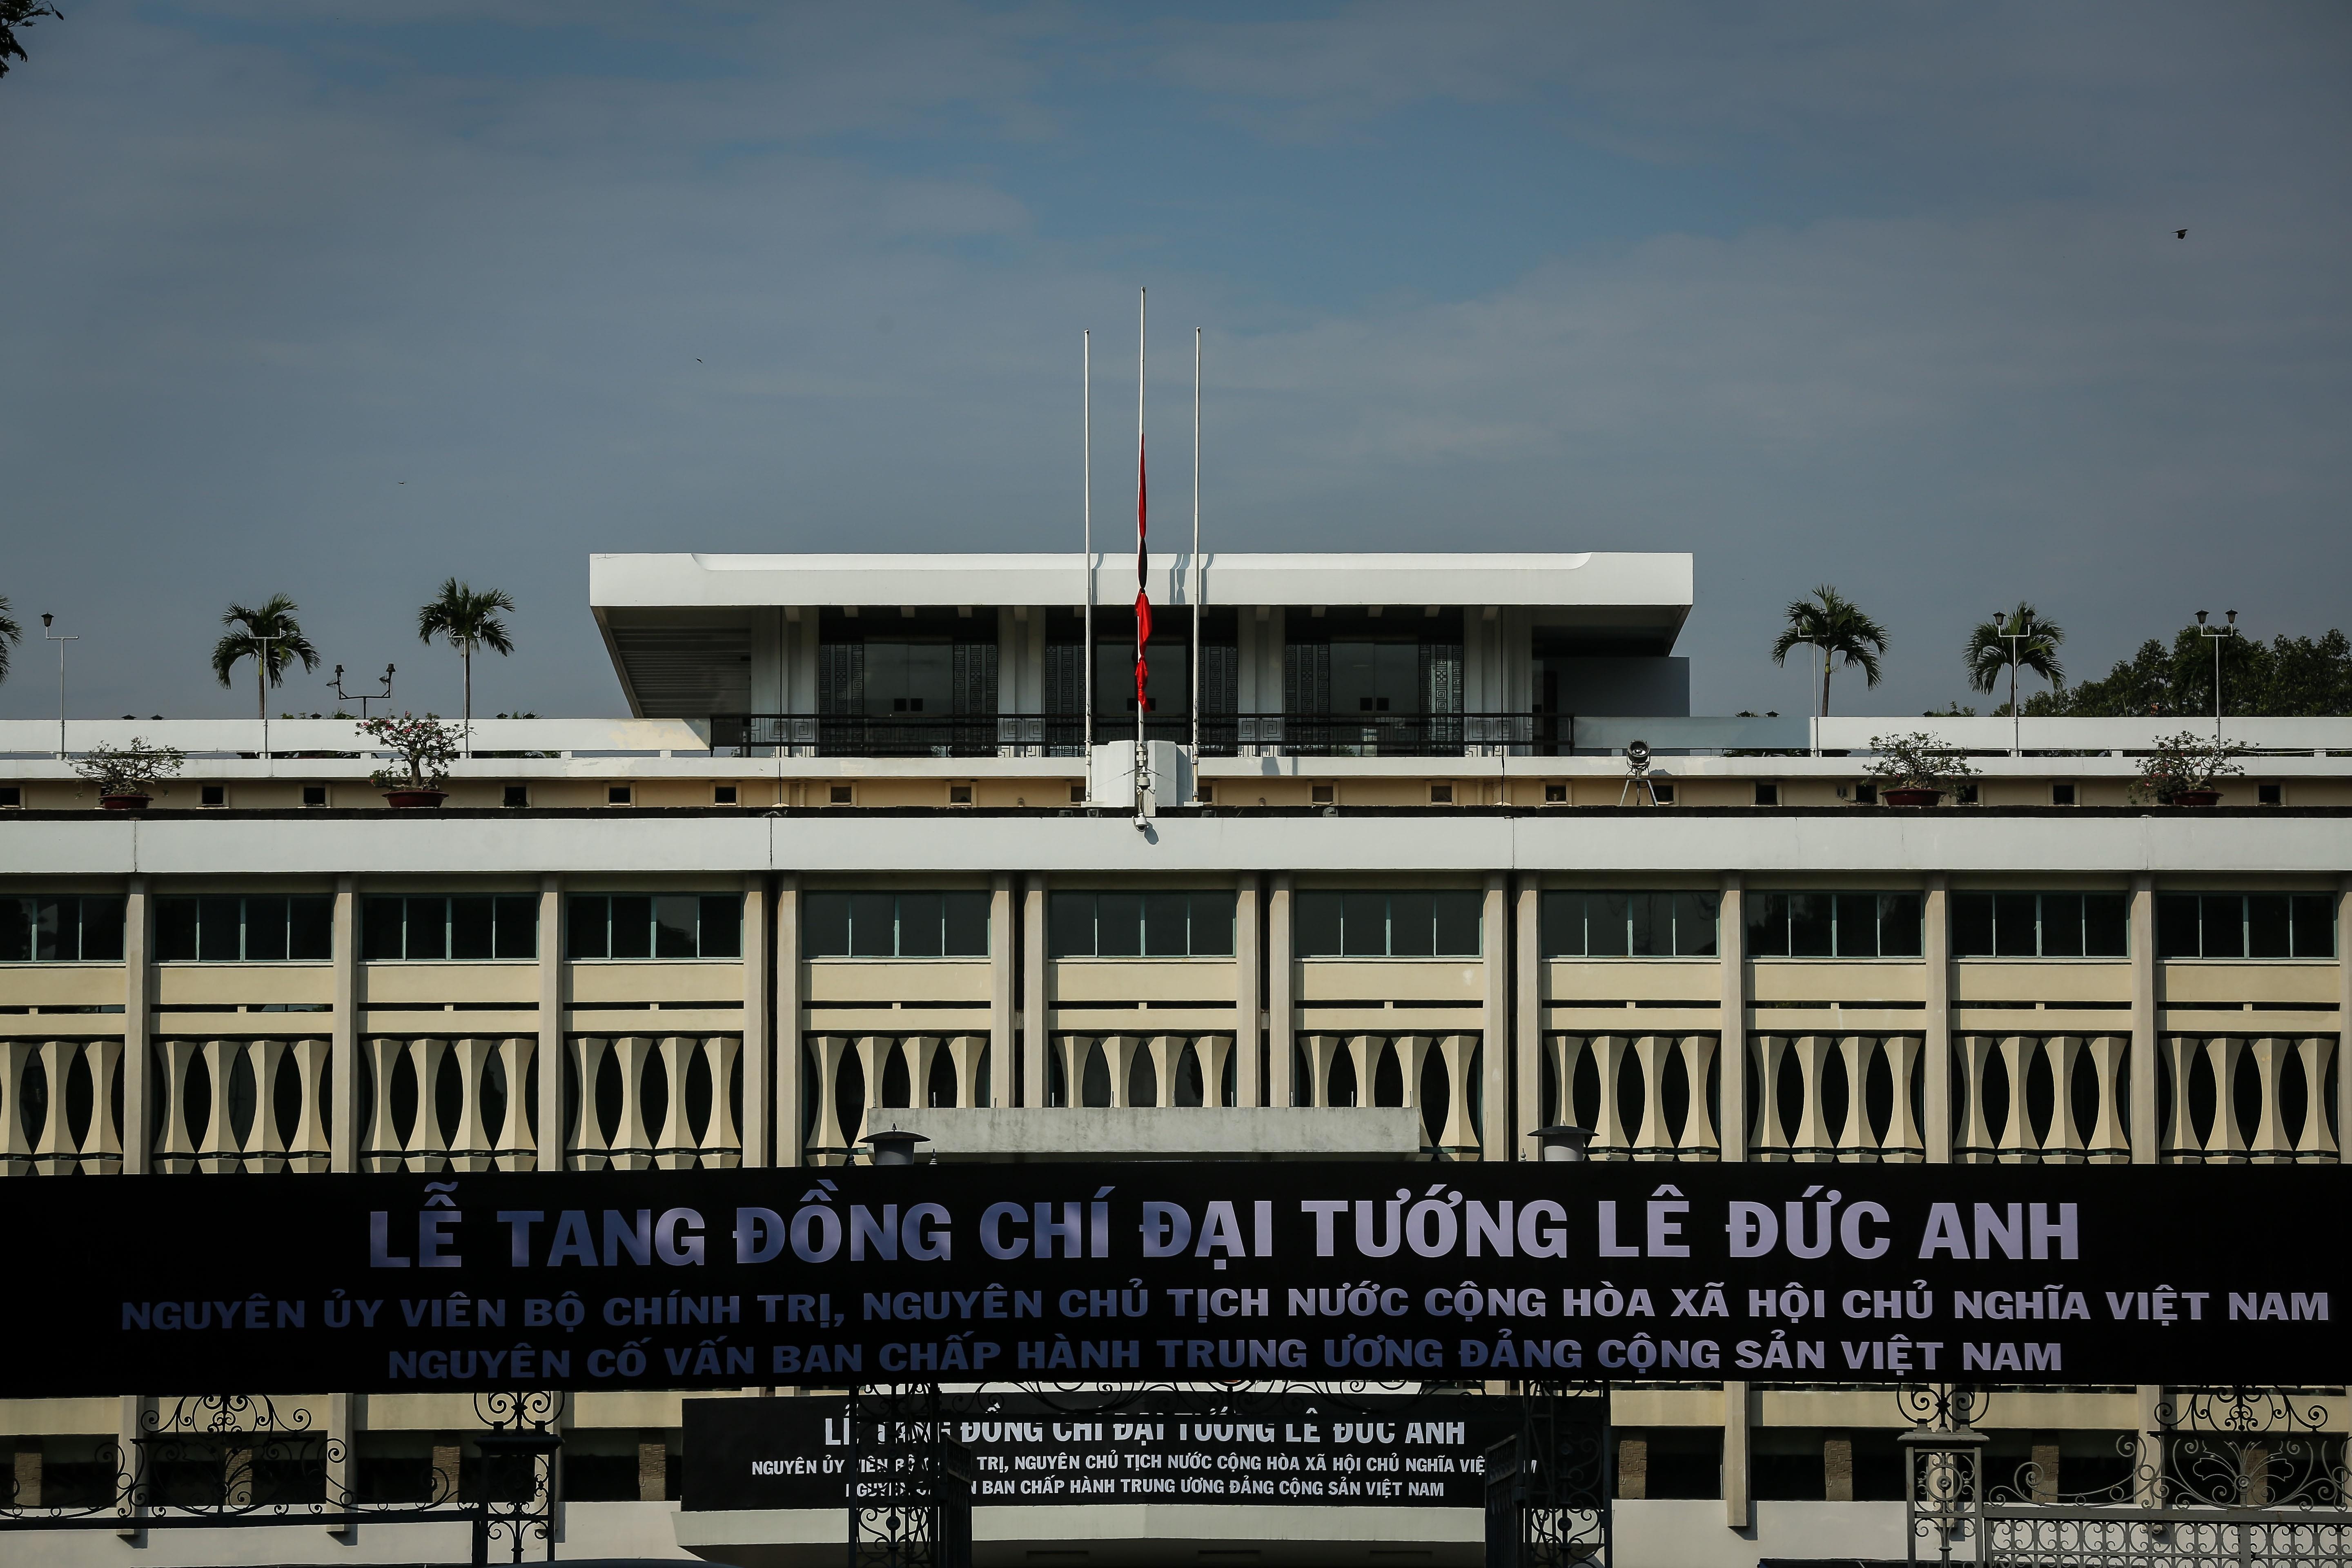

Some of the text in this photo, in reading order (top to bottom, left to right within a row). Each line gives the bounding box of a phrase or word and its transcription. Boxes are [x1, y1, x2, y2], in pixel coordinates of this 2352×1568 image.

[370, 1179, 2078, 1270] LỄ TANG ĐỒNG CHÍ ĐẠI TƯỚNG LÊ ĐỨC ANH
[123, 1278, 2329, 1332] NGUYÊN ỦY VIÊN BỘ CHÍNH TRỊ, NGUYÊN CHỦ TỊCH NƯỚC CỘNG HÒA XÃ HỘI CHỦ NGHĨA VIỆT NAM
[390, 1328, 2061, 1378] NGUYÊN CỐ VẤN BAN CHẤP HÀNH TRUNG ƯƠNG ĐẢNG CỘNG SẢN VIỆT NAM
[1113, 1413, 1164, 1446] ĐẠI
[1286, 1408, 1320, 1442] LÊ
[1405, 1422, 1464, 1444] ANH
[753, 1457, 817, 1474] NGUYÊN
[823, 1454, 845, 1473] ỦY
[977, 1457, 1008, 1473] TRỊ,
[1015, 1452, 1079, 1470] NGUYÊN
[1086, 1450, 1118, 1468] CHỦ
[1125, 1454, 1161, 1471] TỊCH
[1168, 1452, 1212, 1469] NƯỚC
[1217, 1452, 1261, 1472] CỘNG
[1267, 1453, 1300, 1470] HÒA
[1305, 1454, 1326, 1470] XÃ
[1333, 1454, 1361, 1474] HỘI
[1367, 1453, 1399, 1471] CHỦ
[1406, 1455, 1454, 1472] NGHĨA
[1460, 1456, 1485, 1475] VIỆ
[983, 1481, 1015, 1494] BAN
[1021, 1475, 1065, 1494] CHẤP
[1071, 1476, 1114, 1493] HÀNH
[1120, 1479, 1175, 1492] TRUNG
[1181, 1477, 1224, 1493] ƯƠNG
[1229, 1475, 1274, 1494] ĐẢNG
[1279, 1477, 1323, 1497] CỘNG
[1328, 1477, 1360, 1495] SẢN
[1366, 1479, 1402, 1498] VIỆT
[1409, 1482, 1443, 1496] NAM
